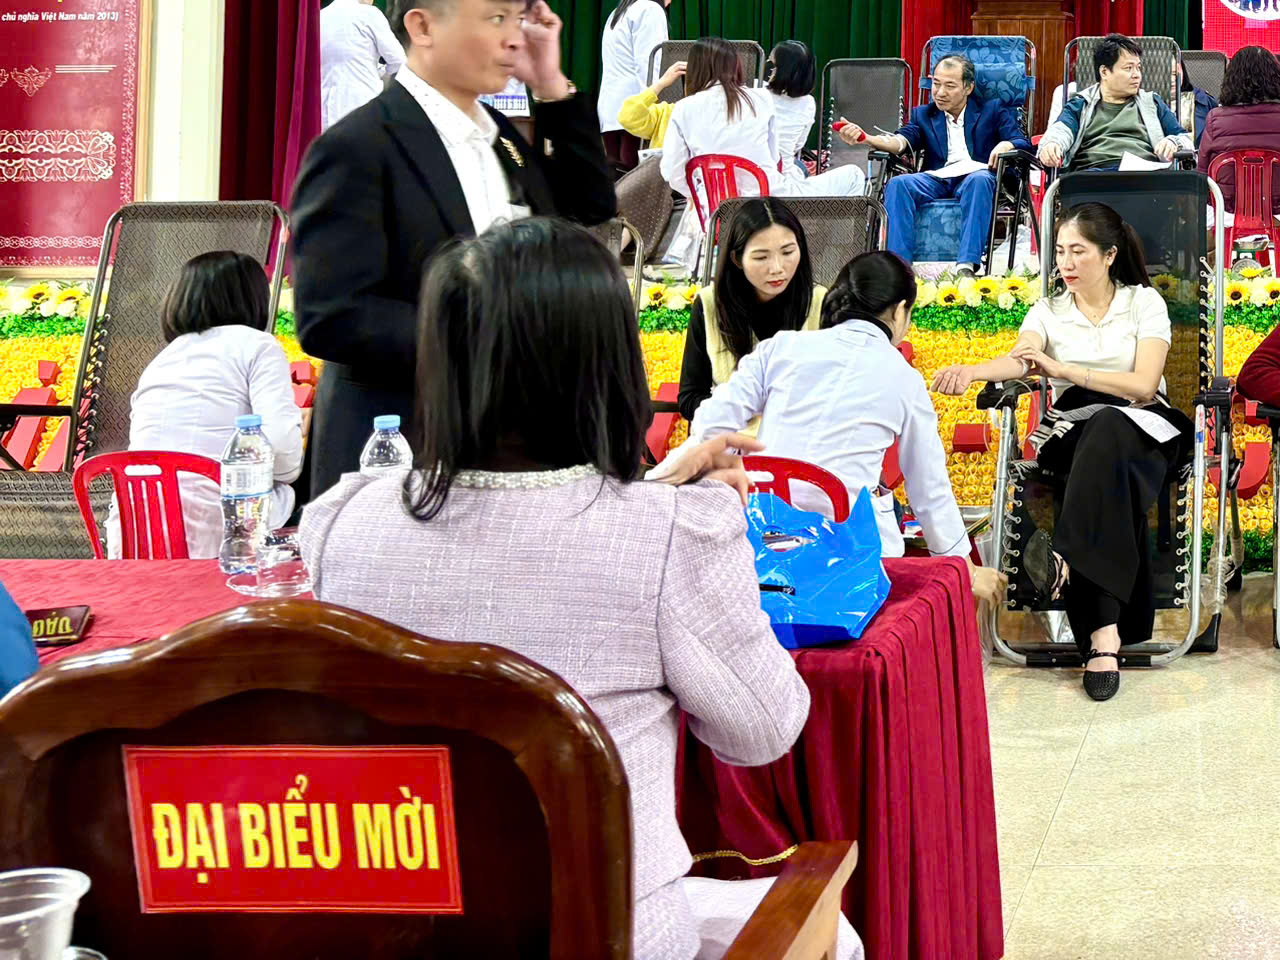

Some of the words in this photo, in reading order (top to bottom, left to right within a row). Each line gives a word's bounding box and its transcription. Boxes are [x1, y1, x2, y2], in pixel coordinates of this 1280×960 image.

[41, 11, 57, 23] Việt
[58, 12, 77, 21] Nam
[78, 11, 95, 21] năm
[96, 11, 119, 22] 2013)
[152, 803, 230, 883] ĐẠI
[238, 774, 341, 869] BIỂU
[352, 786, 440, 870] MỜI
